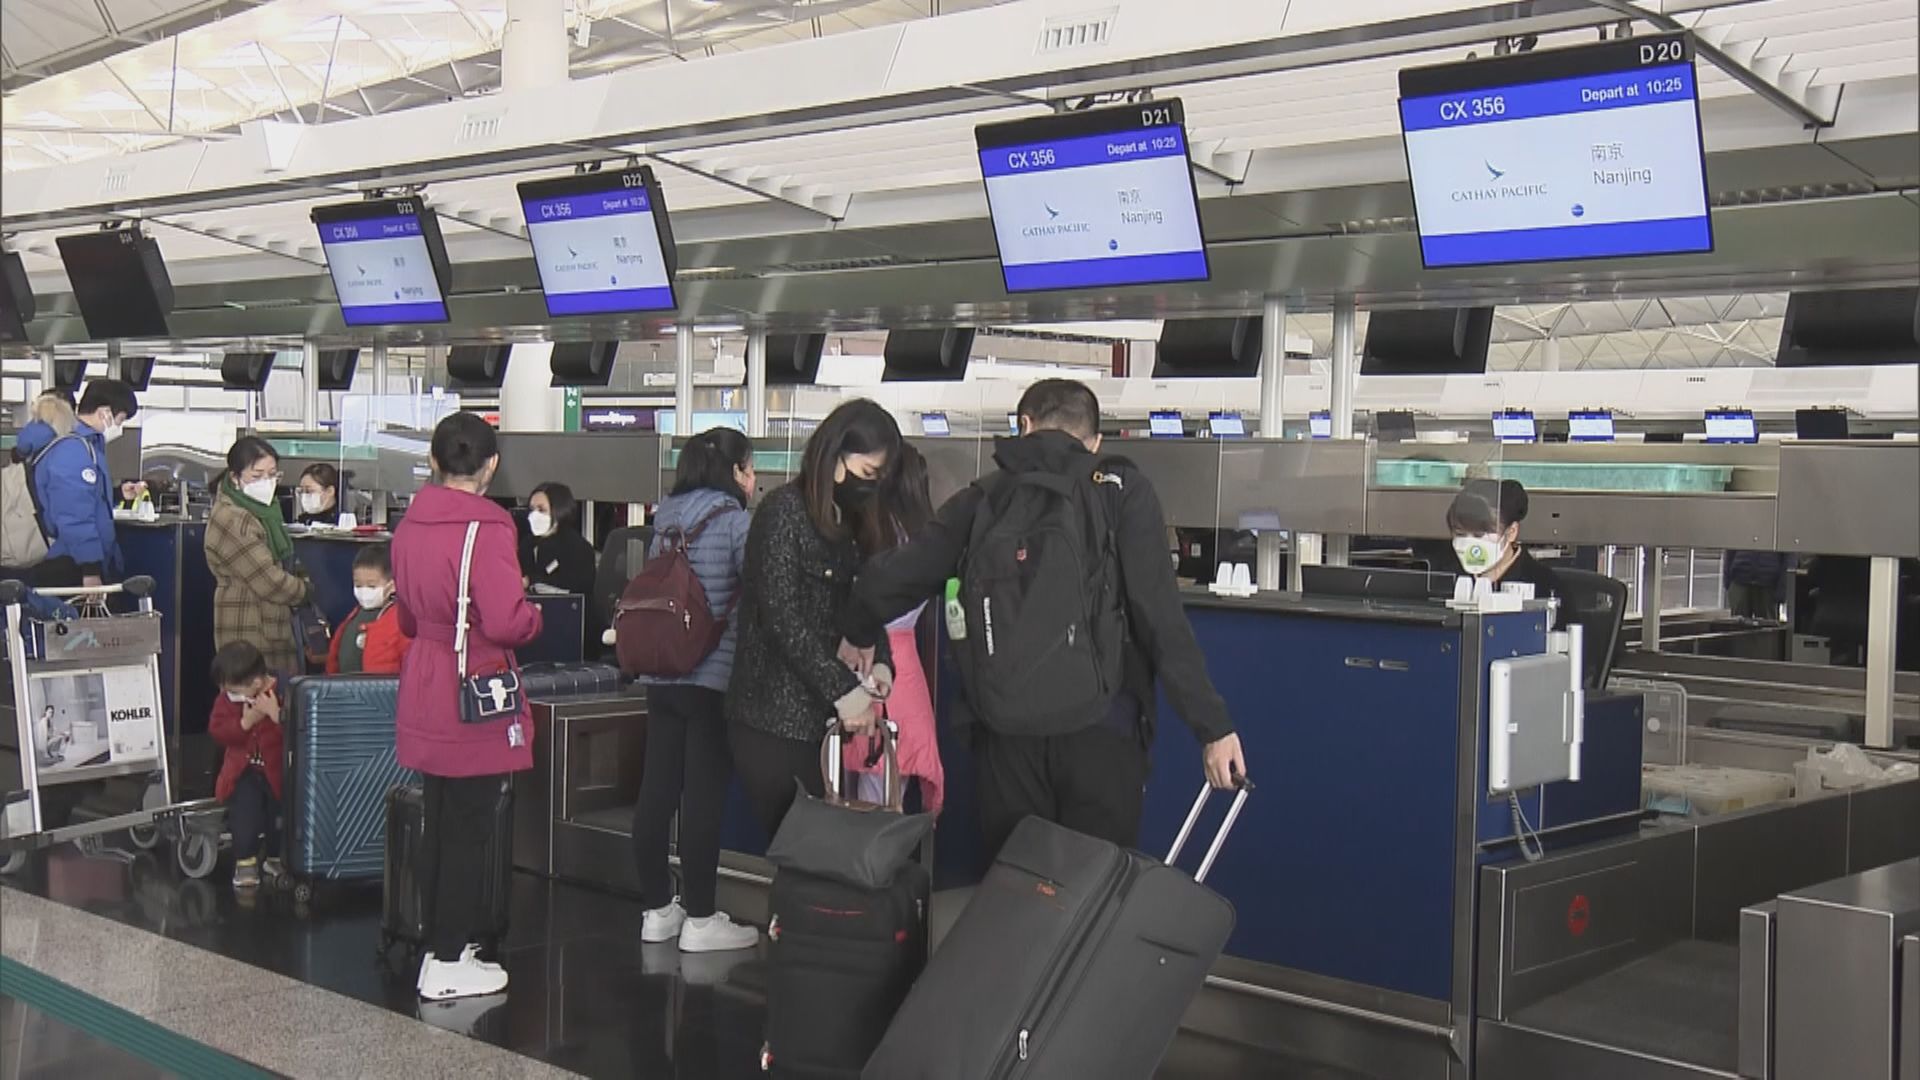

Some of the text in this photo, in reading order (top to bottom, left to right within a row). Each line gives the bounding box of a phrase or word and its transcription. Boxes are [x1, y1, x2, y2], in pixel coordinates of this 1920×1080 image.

[1639, 41, 1683, 64] D20
[1581, 77, 1683, 103] Depart at 10:25
[1141, 108, 1171, 127] D21
[1439, 96, 1506, 121] CX 356
[1107, 136, 1177, 157] Depart at 10:25
[1591, 142, 1625, 162] 南京
[1008, 149, 1056, 169] CX 356
[622, 173, 644, 188] D22
[1593, 166, 1653, 187] Nanjing
[1451, 183, 1548, 203] CATHAY PACIFIC
[541, 202, 572, 219] CX 356
[1121, 209, 1164, 226] Nanjing
[1021, 221, 1091, 238] CATHAY PACIFIC
[110, 706, 153, 722] KOHLER
